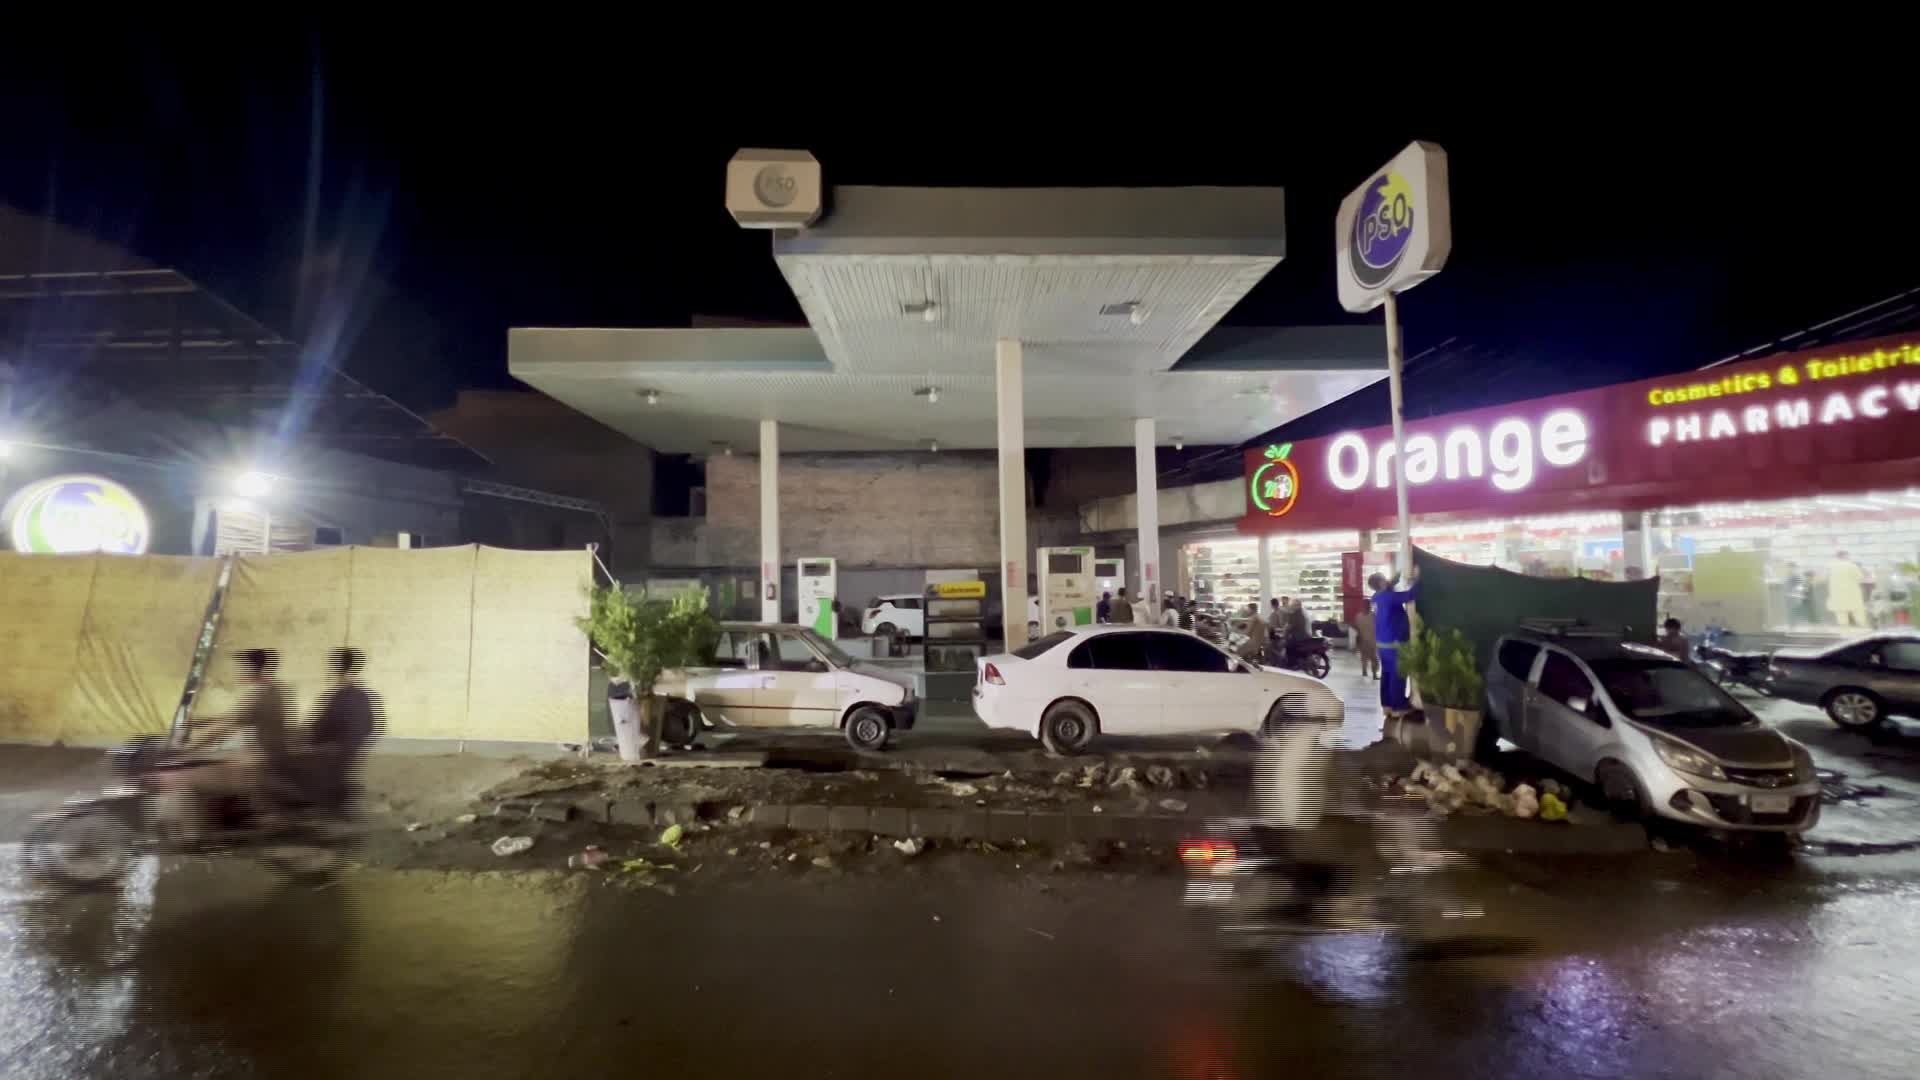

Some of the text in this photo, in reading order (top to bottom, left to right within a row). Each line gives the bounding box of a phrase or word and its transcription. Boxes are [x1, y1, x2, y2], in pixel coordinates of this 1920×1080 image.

[1648, 372, 1771, 406] Cosmetics
[1777, 364, 1798, 385] &
[1648, 382, 1920, 447] PHARMACY
[1327, 410, 1588, 491] Orange
